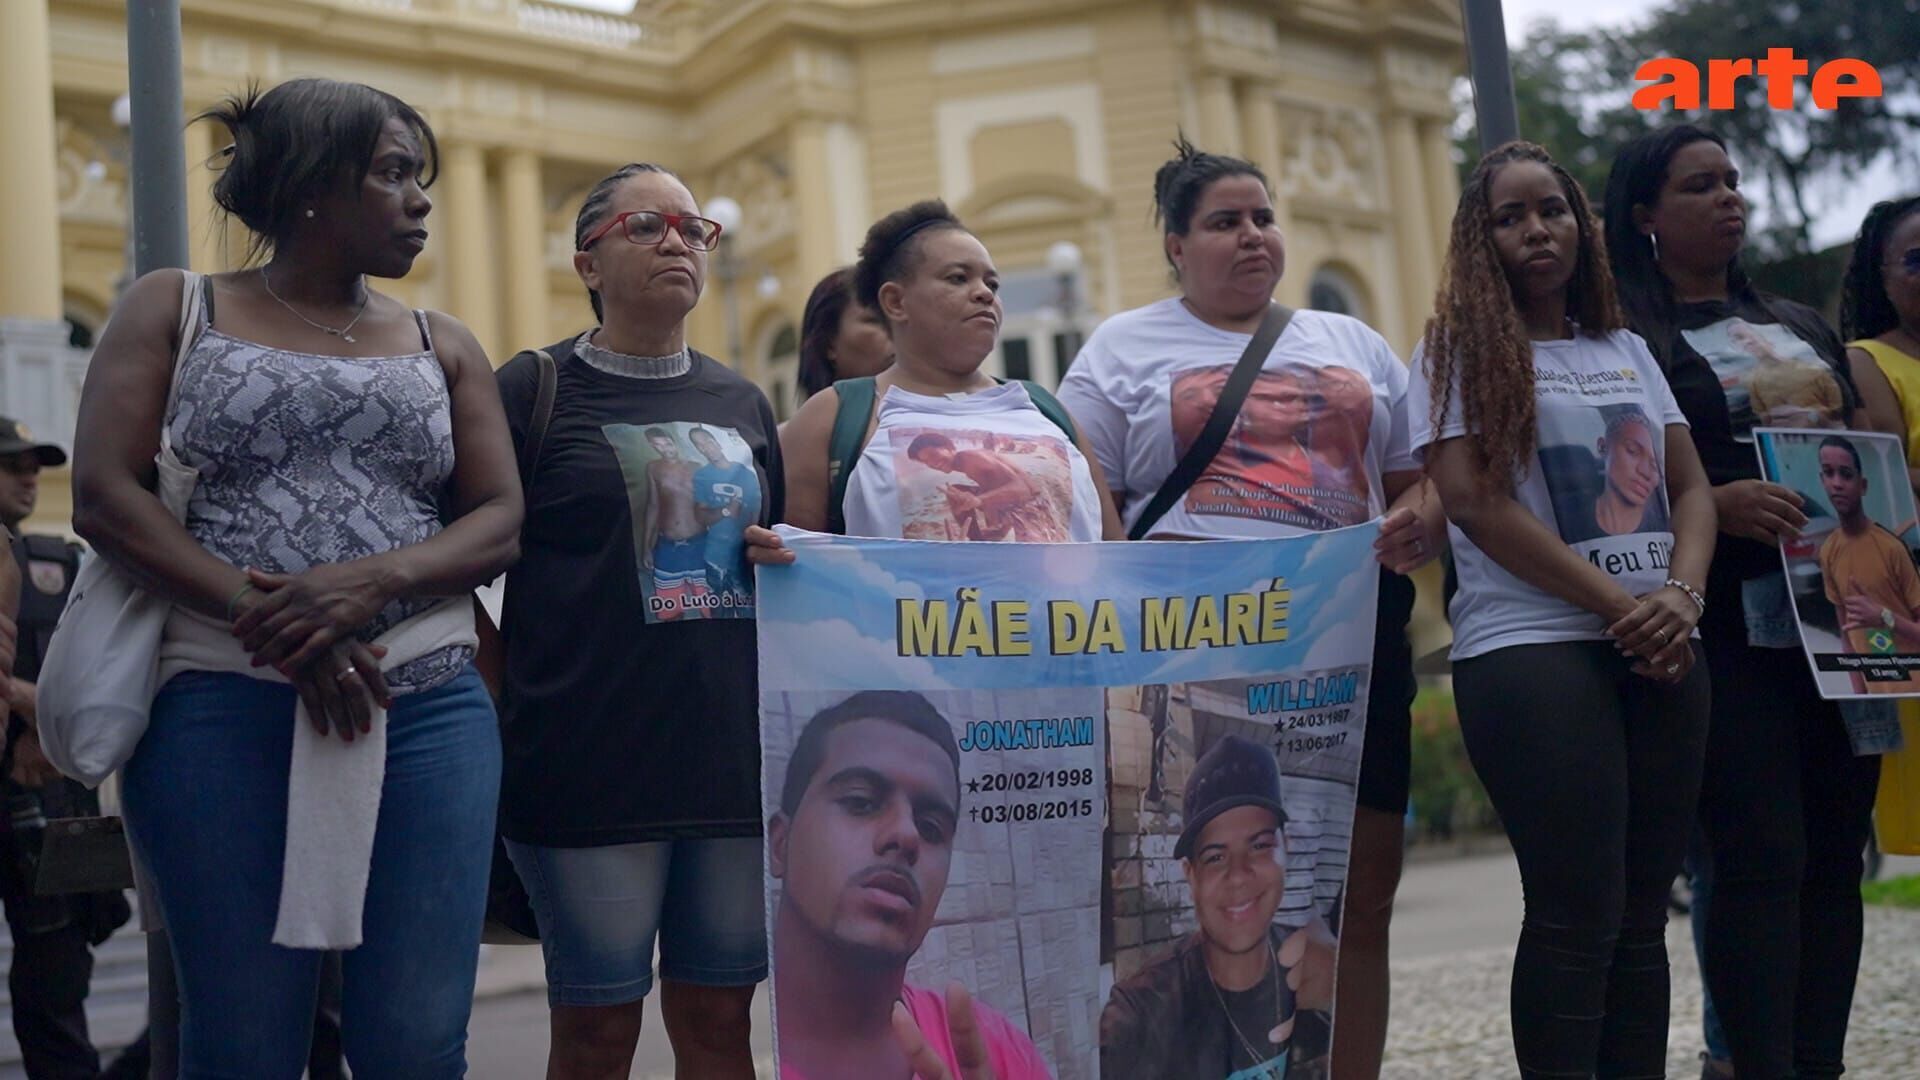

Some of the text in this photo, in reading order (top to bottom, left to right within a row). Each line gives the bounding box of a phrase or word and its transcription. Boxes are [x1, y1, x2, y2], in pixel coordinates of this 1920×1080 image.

[650, 597, 676, 612] Do
[681, 592, 720, 609] Luto
[897, 576, 1292, 656] MÃE DA MARÉ
[1247, 672, 1358, 715] WILLIAM
[959, 716, 1094, 751] JONATHAM
[981, 768, 1093, 792] 20/02/1998
[981, 799, 1093, 823] 03/08/2015
